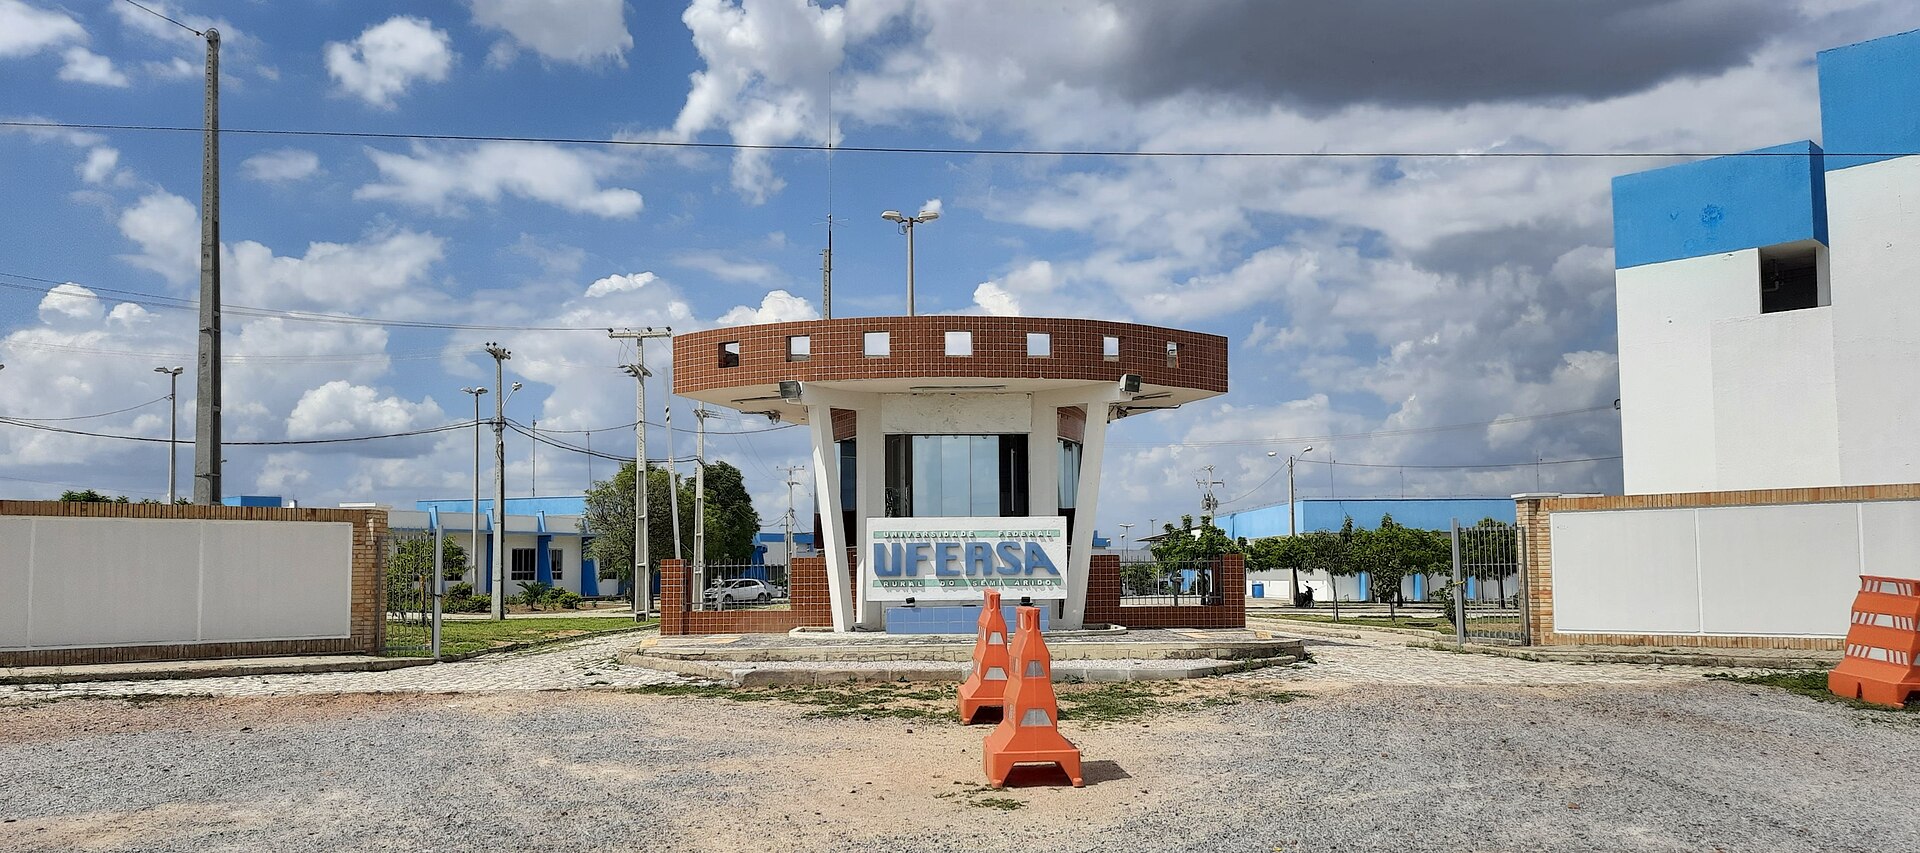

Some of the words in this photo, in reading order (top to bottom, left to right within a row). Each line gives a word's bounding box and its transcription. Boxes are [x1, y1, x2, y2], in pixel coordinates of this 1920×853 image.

[883, 530, 976, 538] UNIVERSIDADE
[998, 530, 1052, 538] FEDERAL
[873, 541, 1061, 577] UFERSA
[883, 579, 923, 587] RURAL
[939, 579, 955, 587] DO
[972, 579, 1003, 587] SEMI
